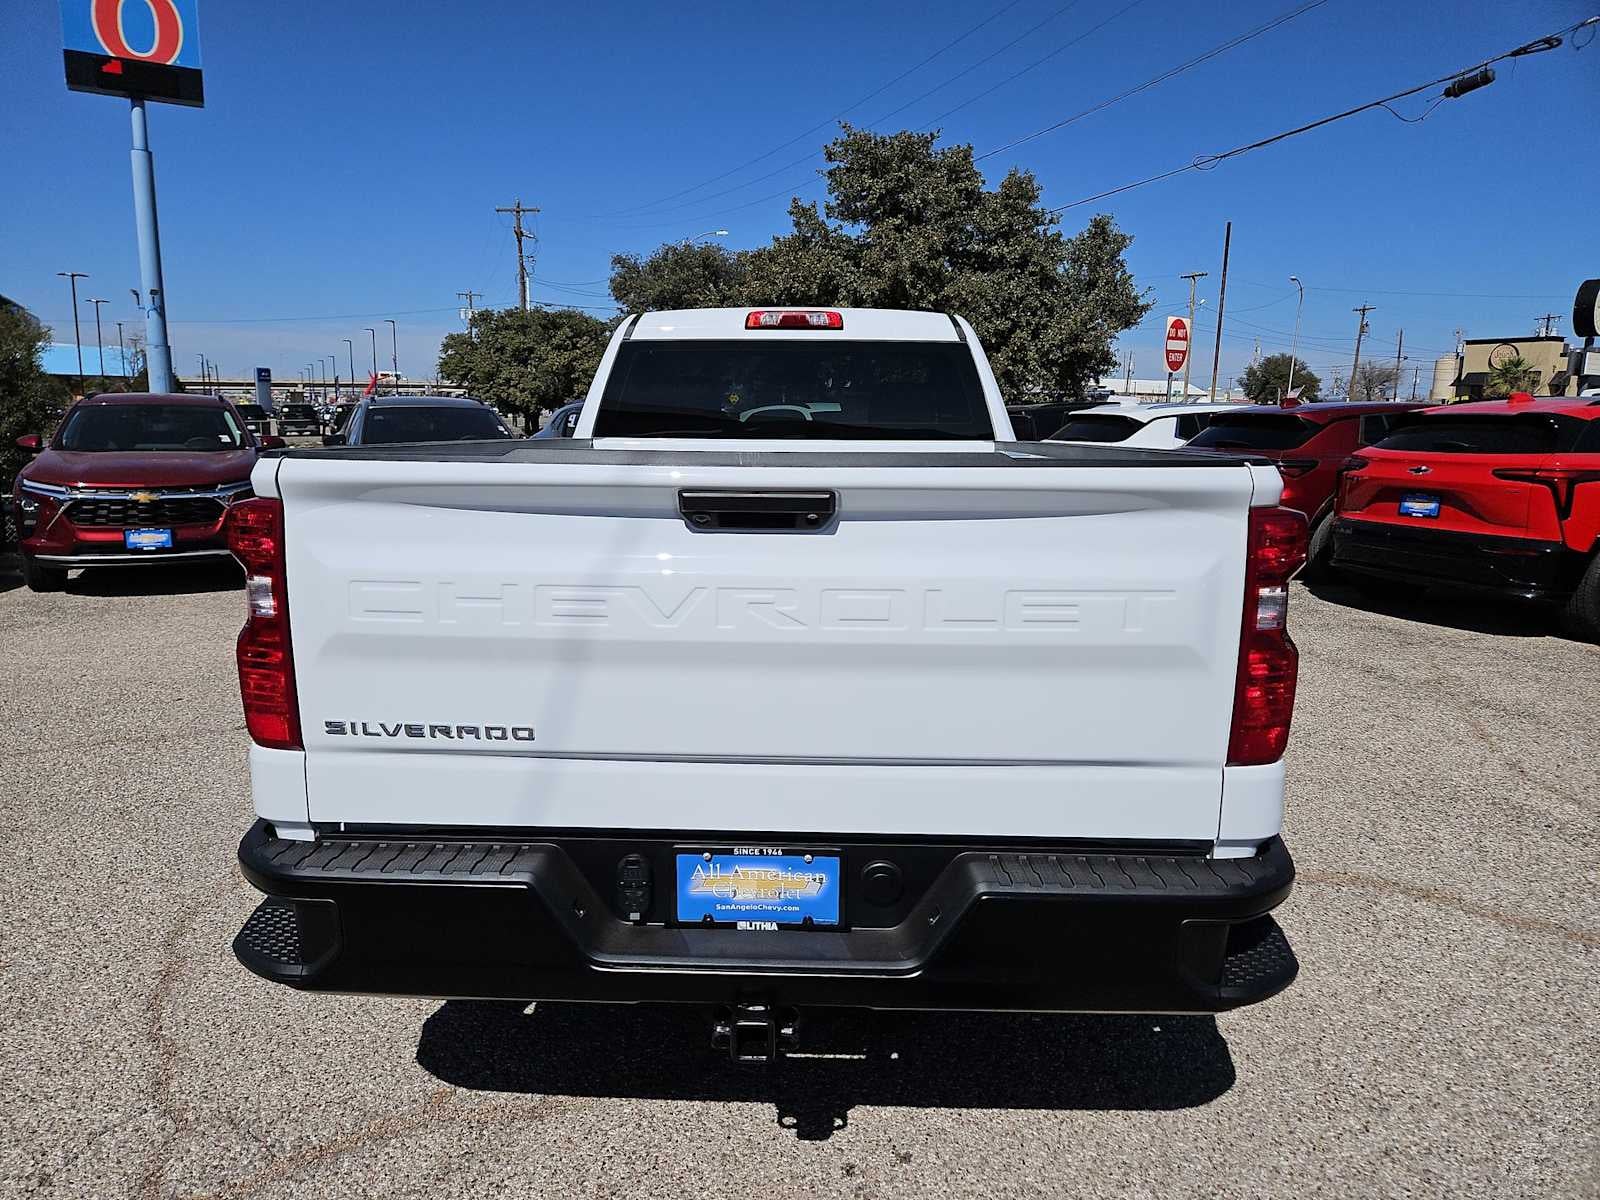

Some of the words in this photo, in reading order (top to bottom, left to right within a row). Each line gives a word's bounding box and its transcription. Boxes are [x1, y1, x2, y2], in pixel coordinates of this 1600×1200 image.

[1169, 328, 1176, 338] DO
[1177, 329, 1186, 338] NOT
[1168, 353, 1183, 362] ENTER
[348, 580, 1177, 632] CHEVROLET
[324, 720, 536, 742] SILVERADO
[733, 848, 760, 856] SINCE
[762, 848, 783, 856] 1946
[690, 863, 721, 881] All
[728, 864, 828, 883] American
[712, 881, 802, 900] Chevrolet
[715, 903, 800, 912] SanAngeloChevy.com
[746, 920, 778, 931] LITHIA
